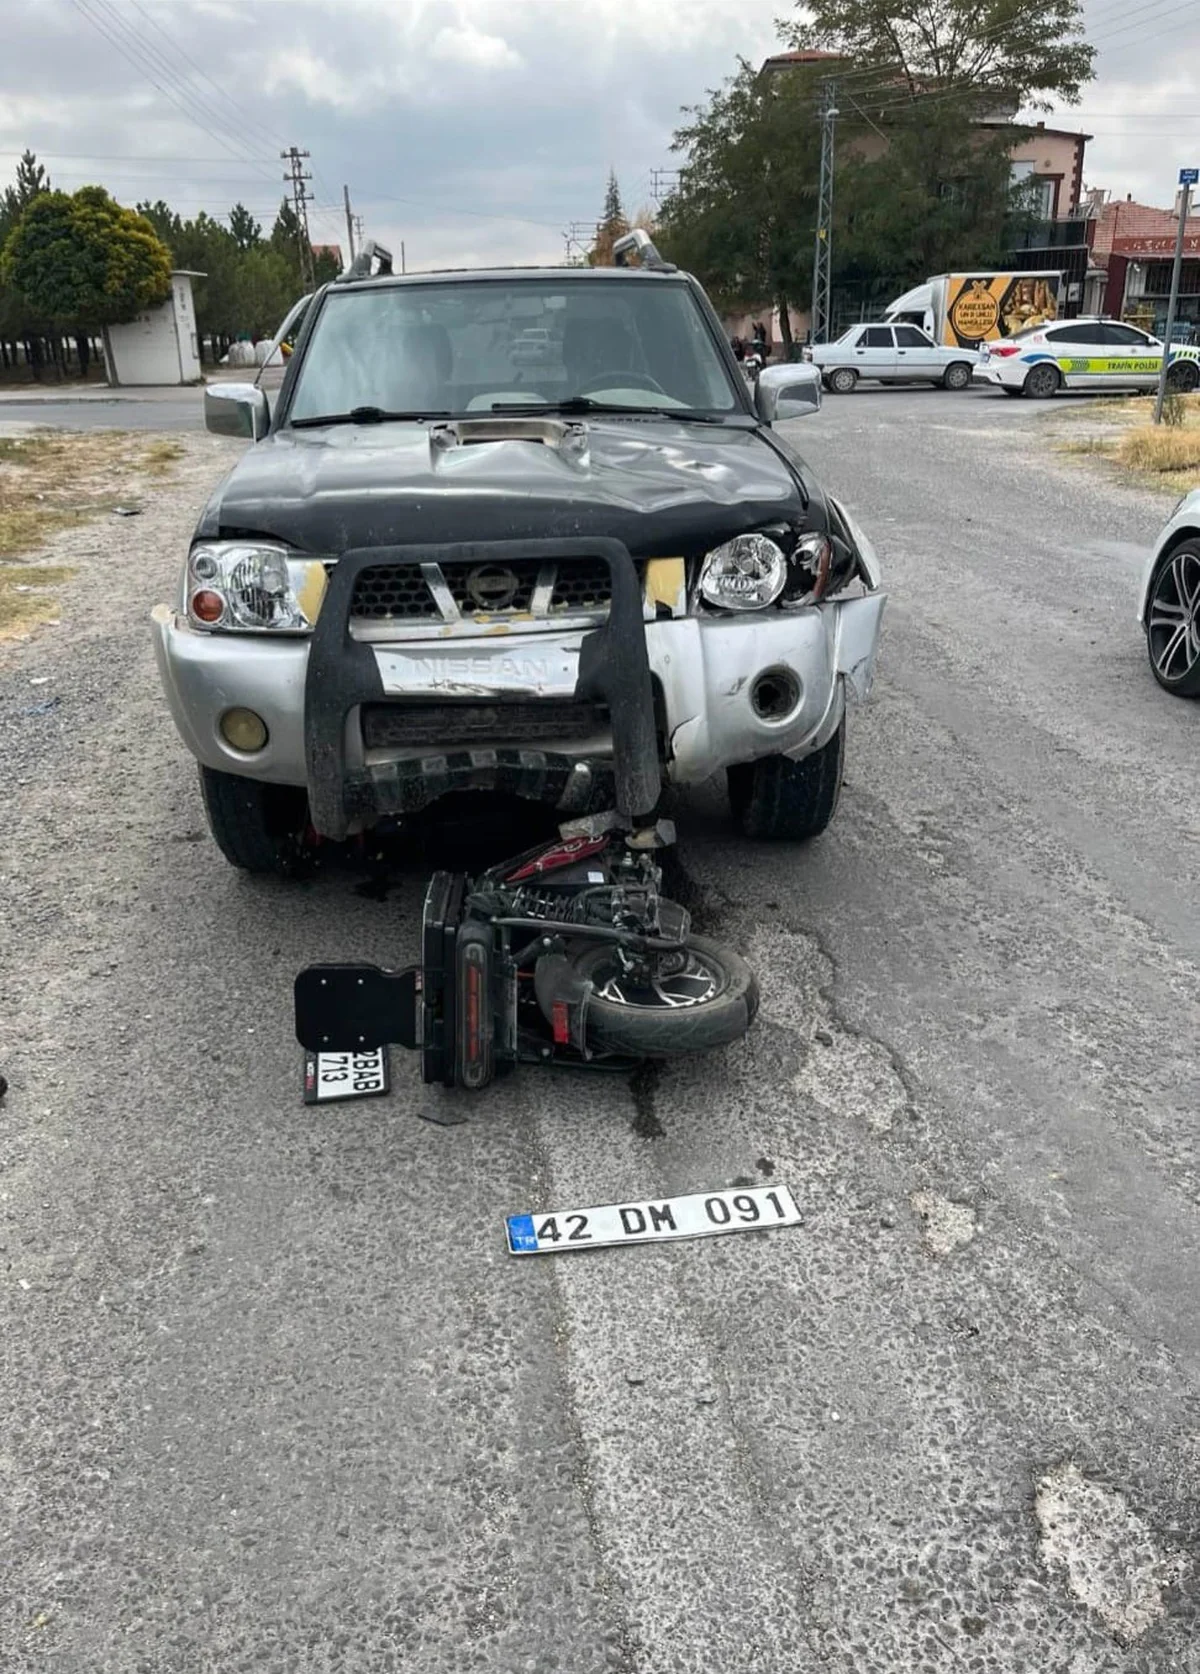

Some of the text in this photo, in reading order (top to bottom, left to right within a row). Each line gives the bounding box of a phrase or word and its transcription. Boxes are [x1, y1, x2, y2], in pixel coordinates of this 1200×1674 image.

[412, 657, 549, 677] NISSAN
[321, 1056, 348, 1083] 713
[537, 1192, 786, 1242] 42 DM 091
[514, 1236, 535, 1245] TR
